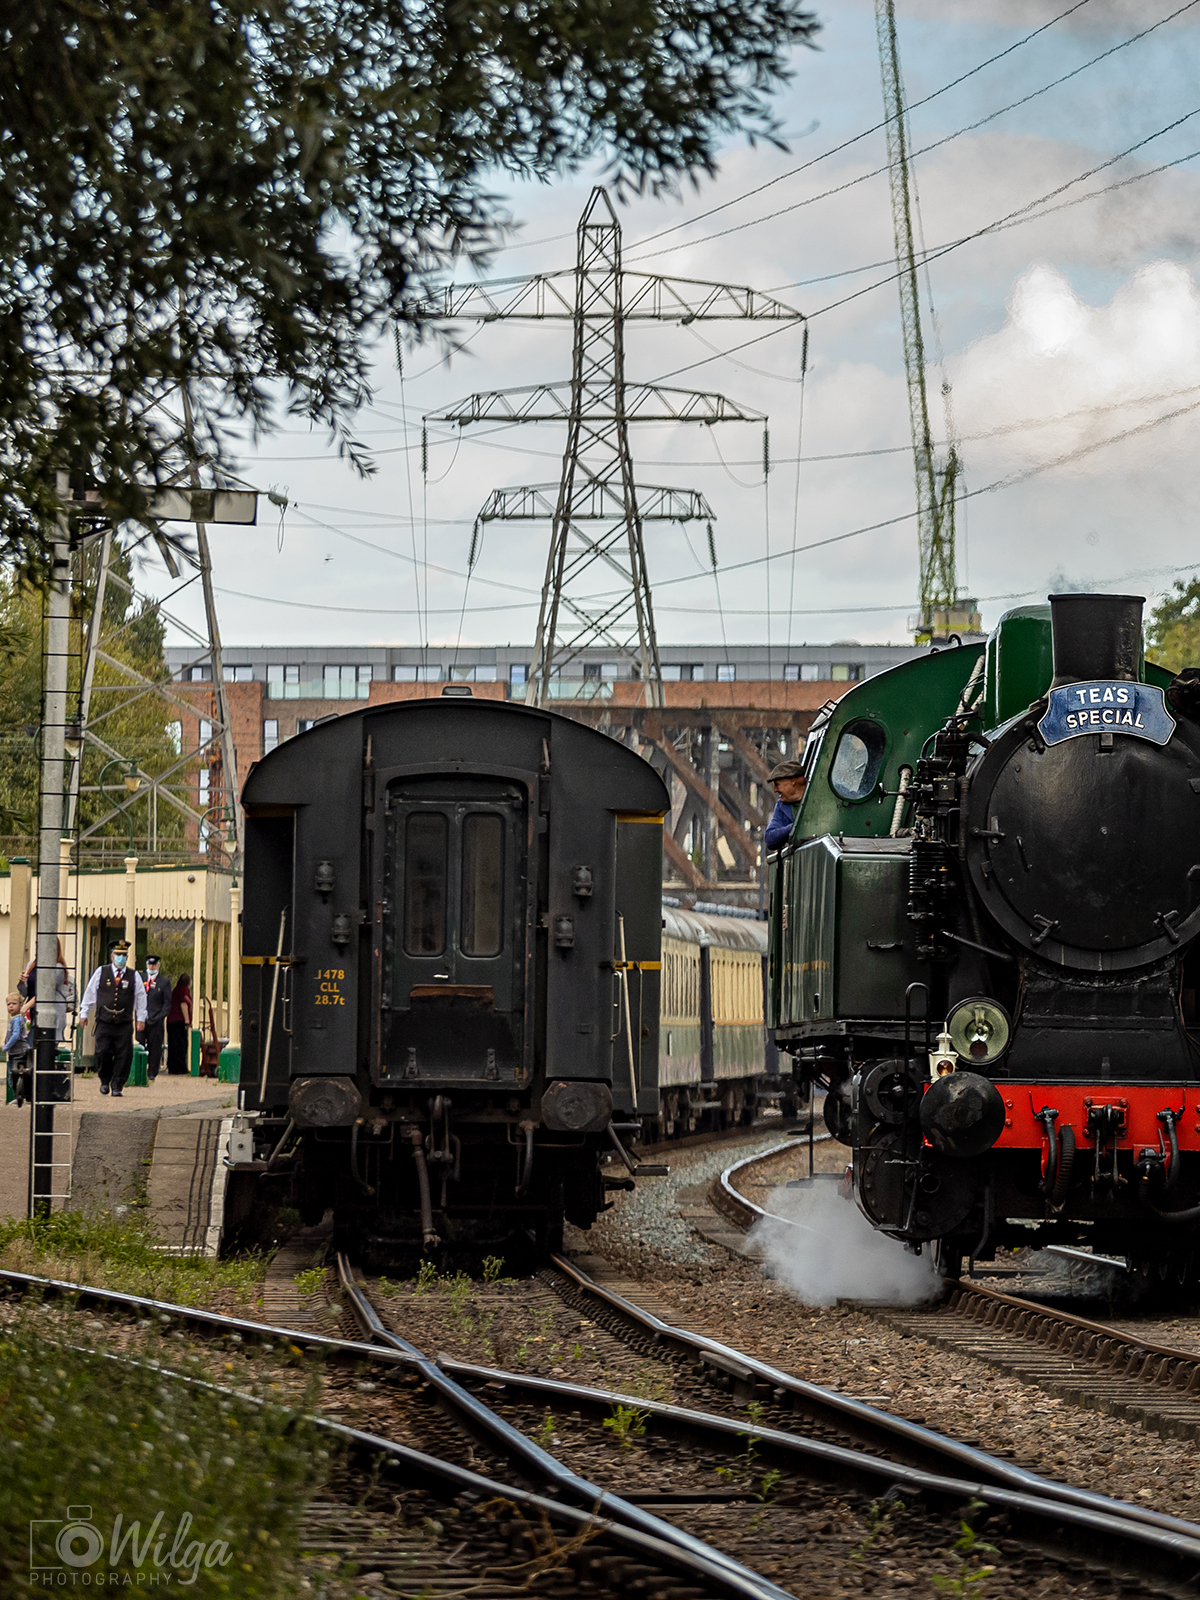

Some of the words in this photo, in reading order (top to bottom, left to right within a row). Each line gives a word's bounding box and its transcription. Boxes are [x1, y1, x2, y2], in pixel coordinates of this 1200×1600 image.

[1076, 686, 1129, 705] TEA'S
[1066, 709, 1145, 729] SPECIAL
[320, 982, 340, 993] CLL
[314, 994, 346, 1006] 28.7t
